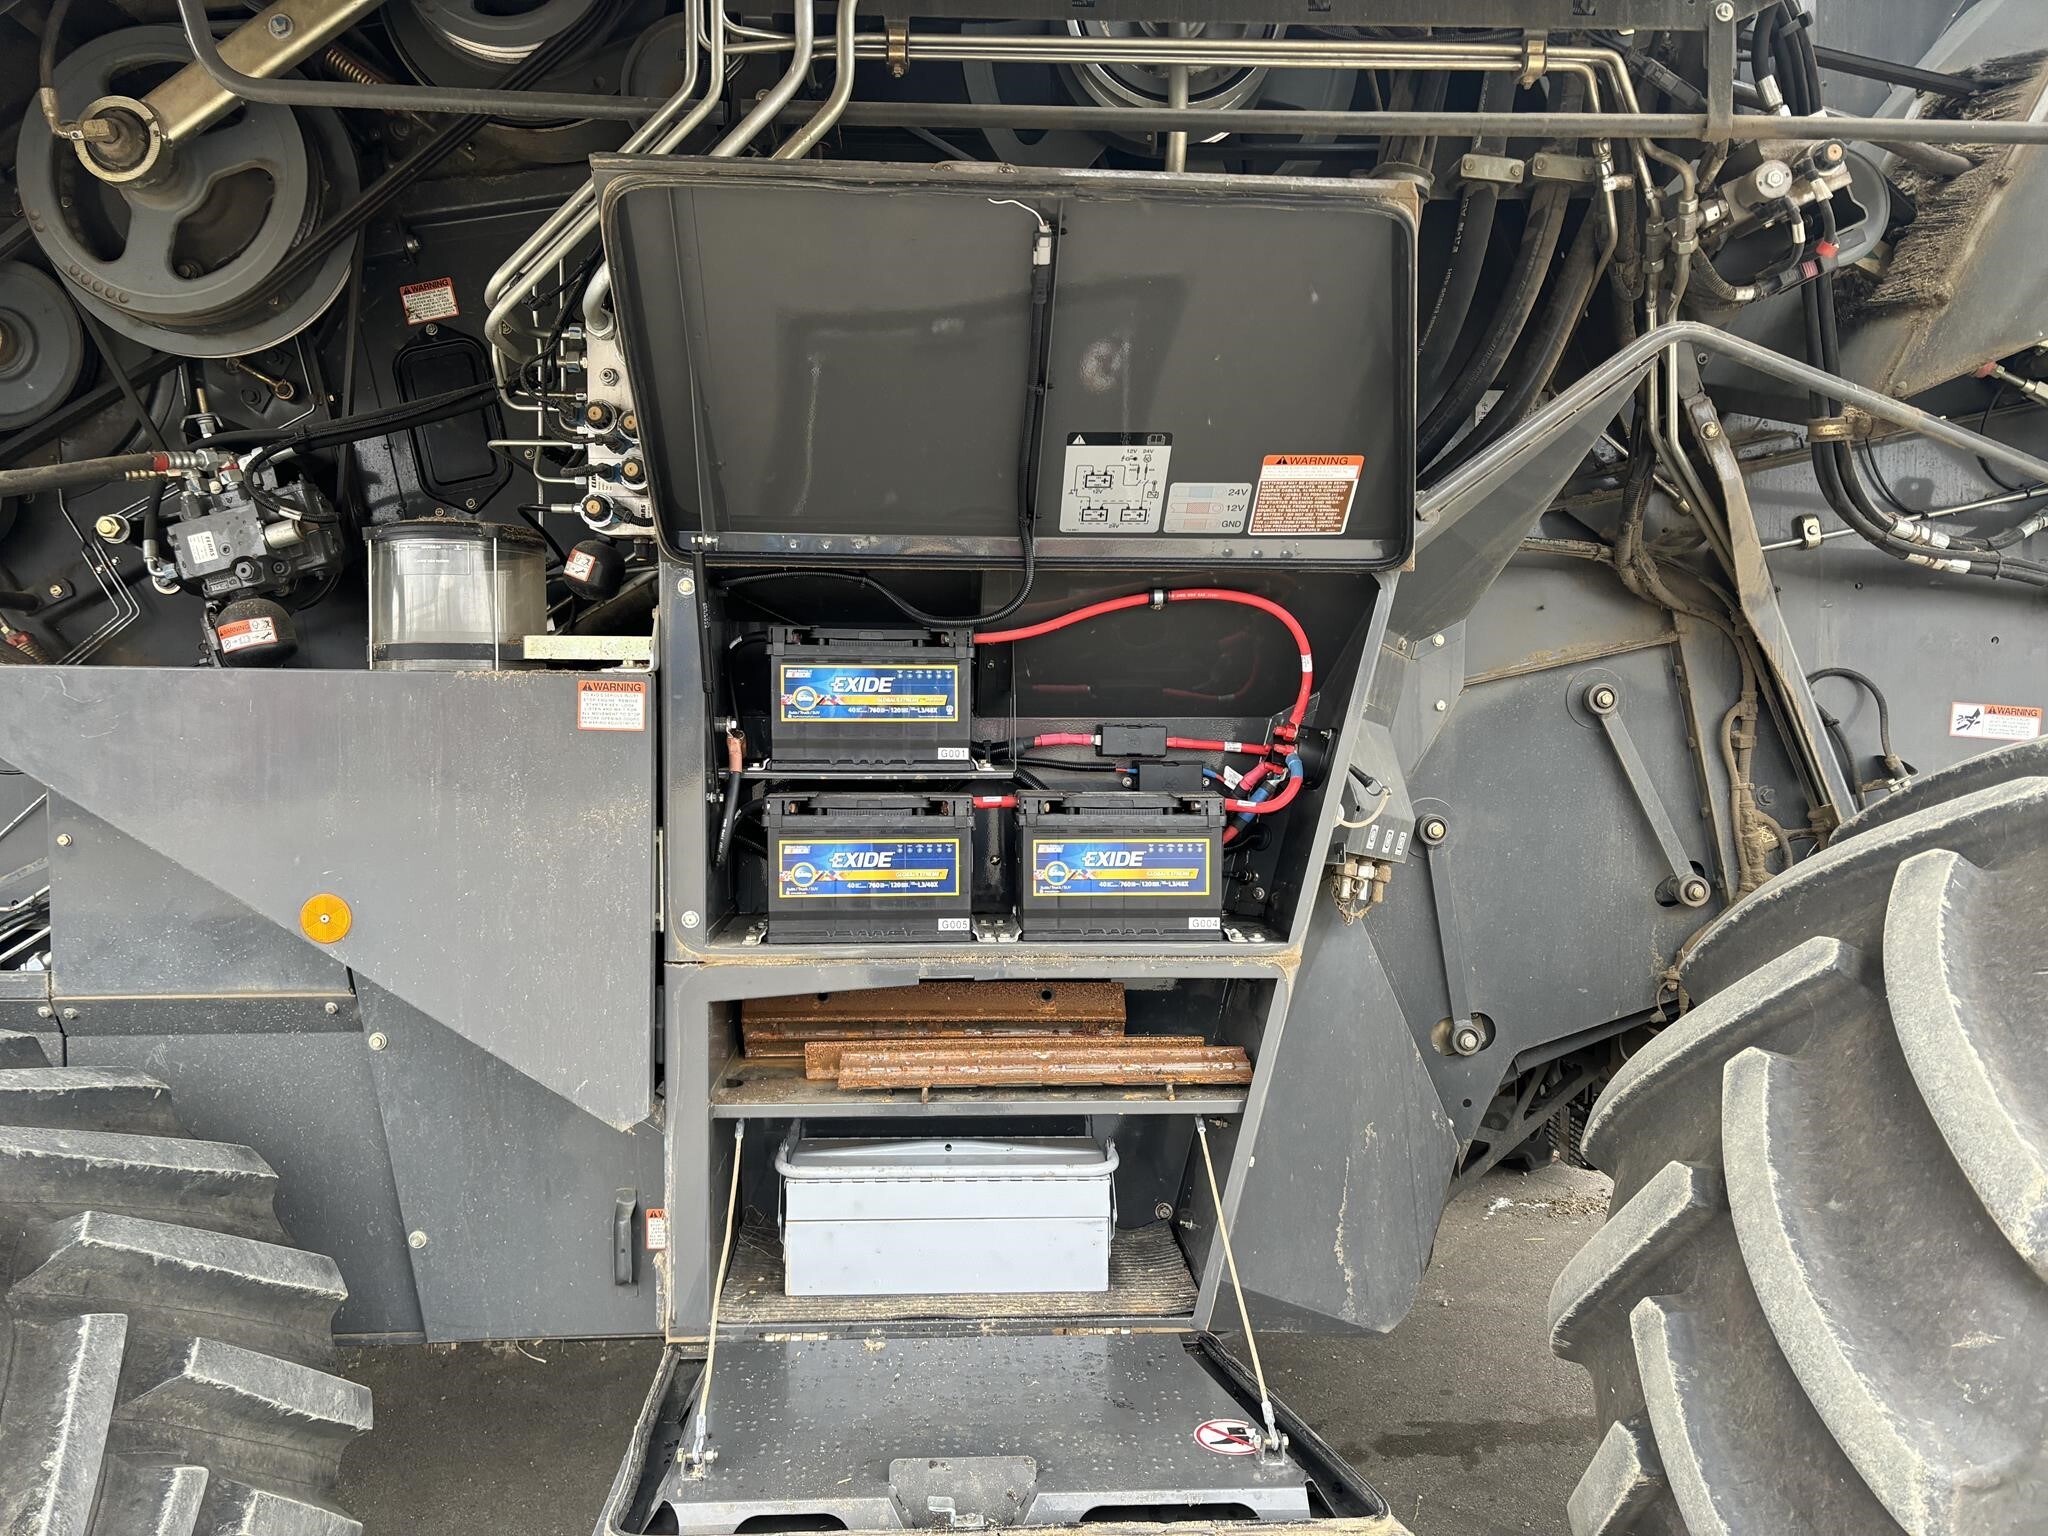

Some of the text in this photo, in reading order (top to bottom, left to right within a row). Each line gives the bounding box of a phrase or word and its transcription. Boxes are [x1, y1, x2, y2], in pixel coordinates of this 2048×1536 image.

[412, 279, 448, 292] WARNING
[1290, 456, 1348, 464] WARNING
[594, 682, 641, 692] WARNING
[830, 676, 894, 692] EXIDE
[1997, 706, 2037, 716] WARNING
[941, 749, 966, 758] G001
[830, 852, 893, 868] EXIDE
[1082, 851, 1144, 866] EXIDE
[942, 920, 968, 929] G005
[1192, 919, 1218, 928] G004
